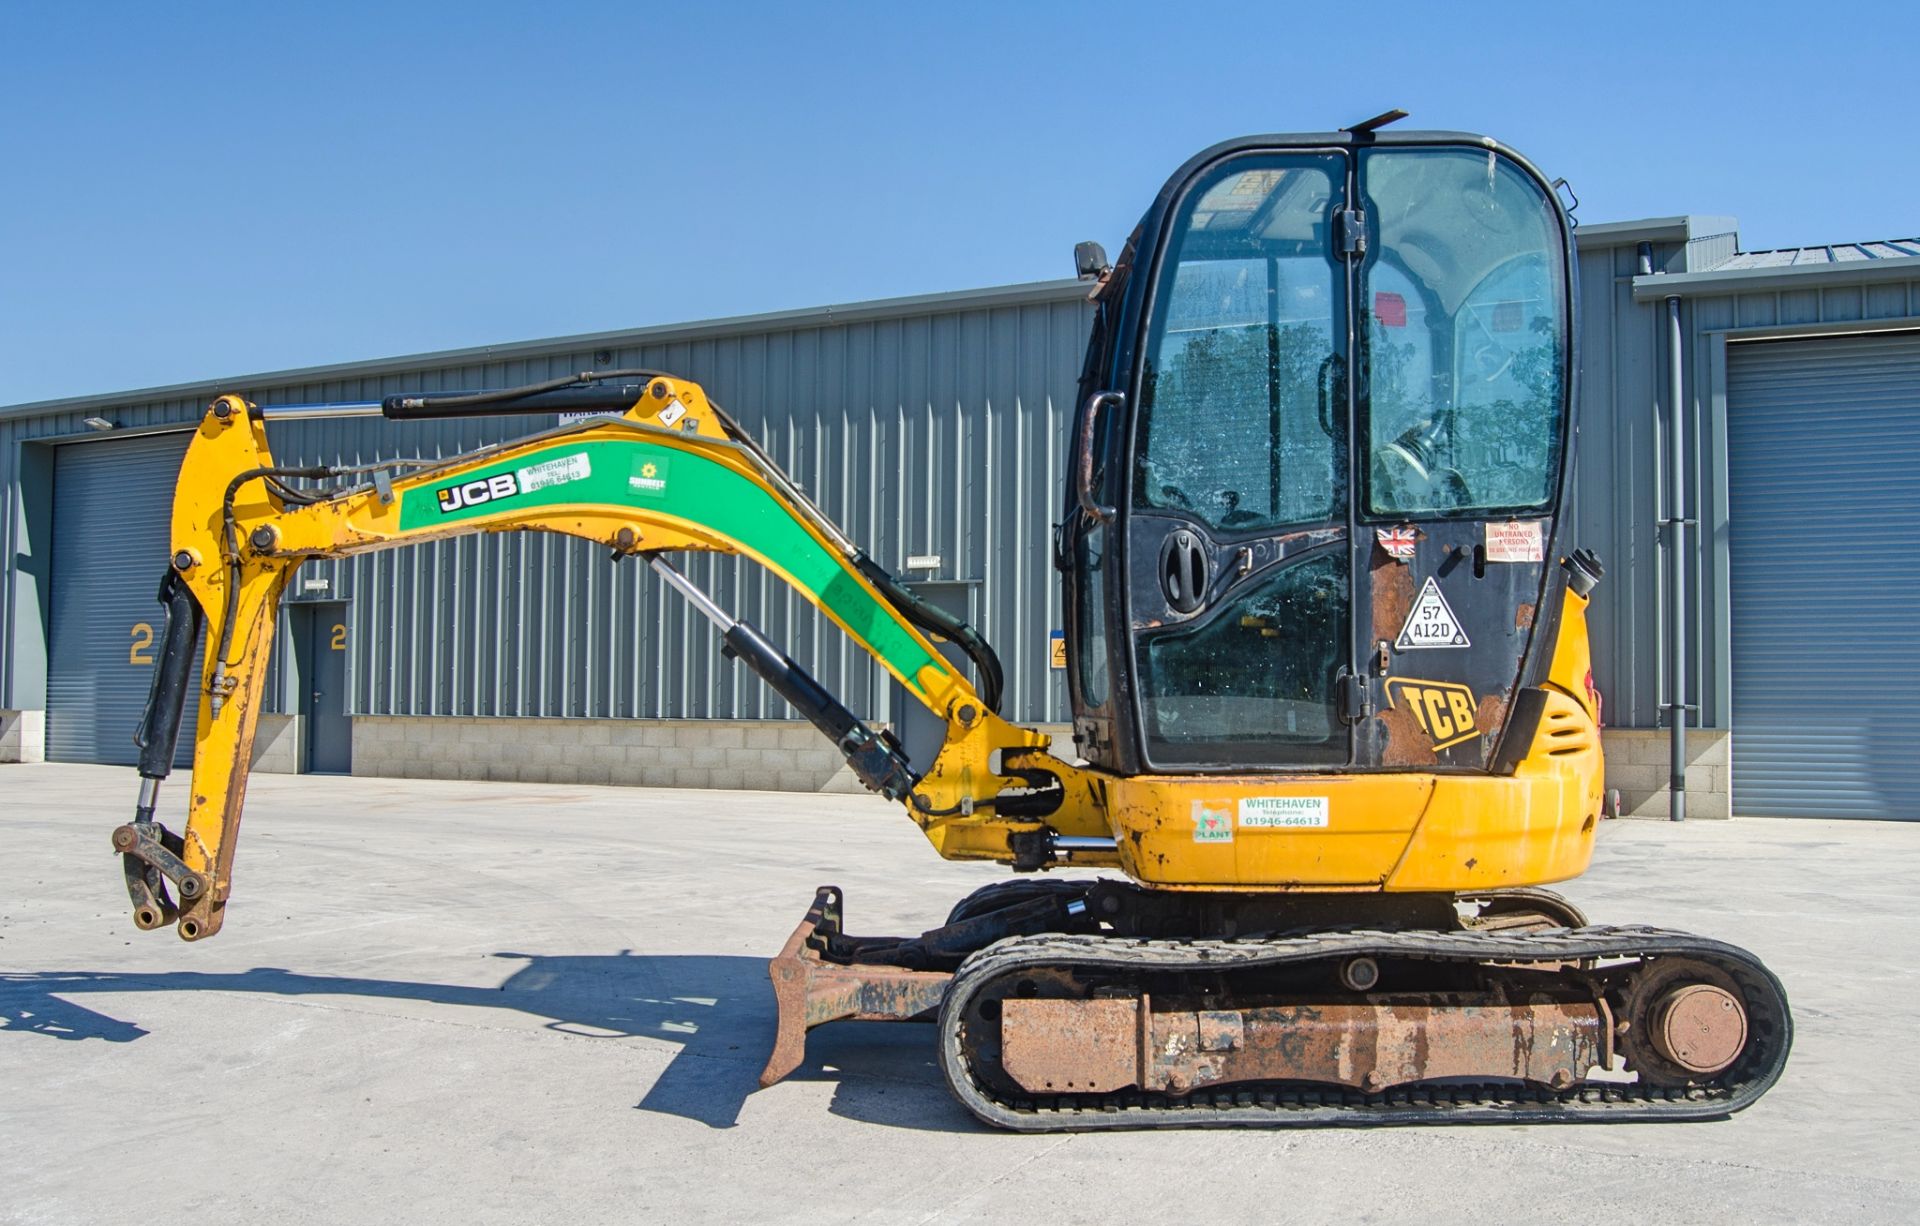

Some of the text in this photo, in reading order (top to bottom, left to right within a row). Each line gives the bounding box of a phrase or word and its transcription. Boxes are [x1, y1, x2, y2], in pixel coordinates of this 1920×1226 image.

[526, 457, 578, 476] WHITEHAVEN
[439, 473, 518, 512] JCB
[1423, 606, 1440, 621] 57
[130, 622, 154, 664] 2
[331, 624, 347, 650] 2
[1246, 799, 1321, 808] WHITEHAVEN
[1246, 816, 1321, 825] 01946-64613
[1195, 830, 1230, 838] PLANT
